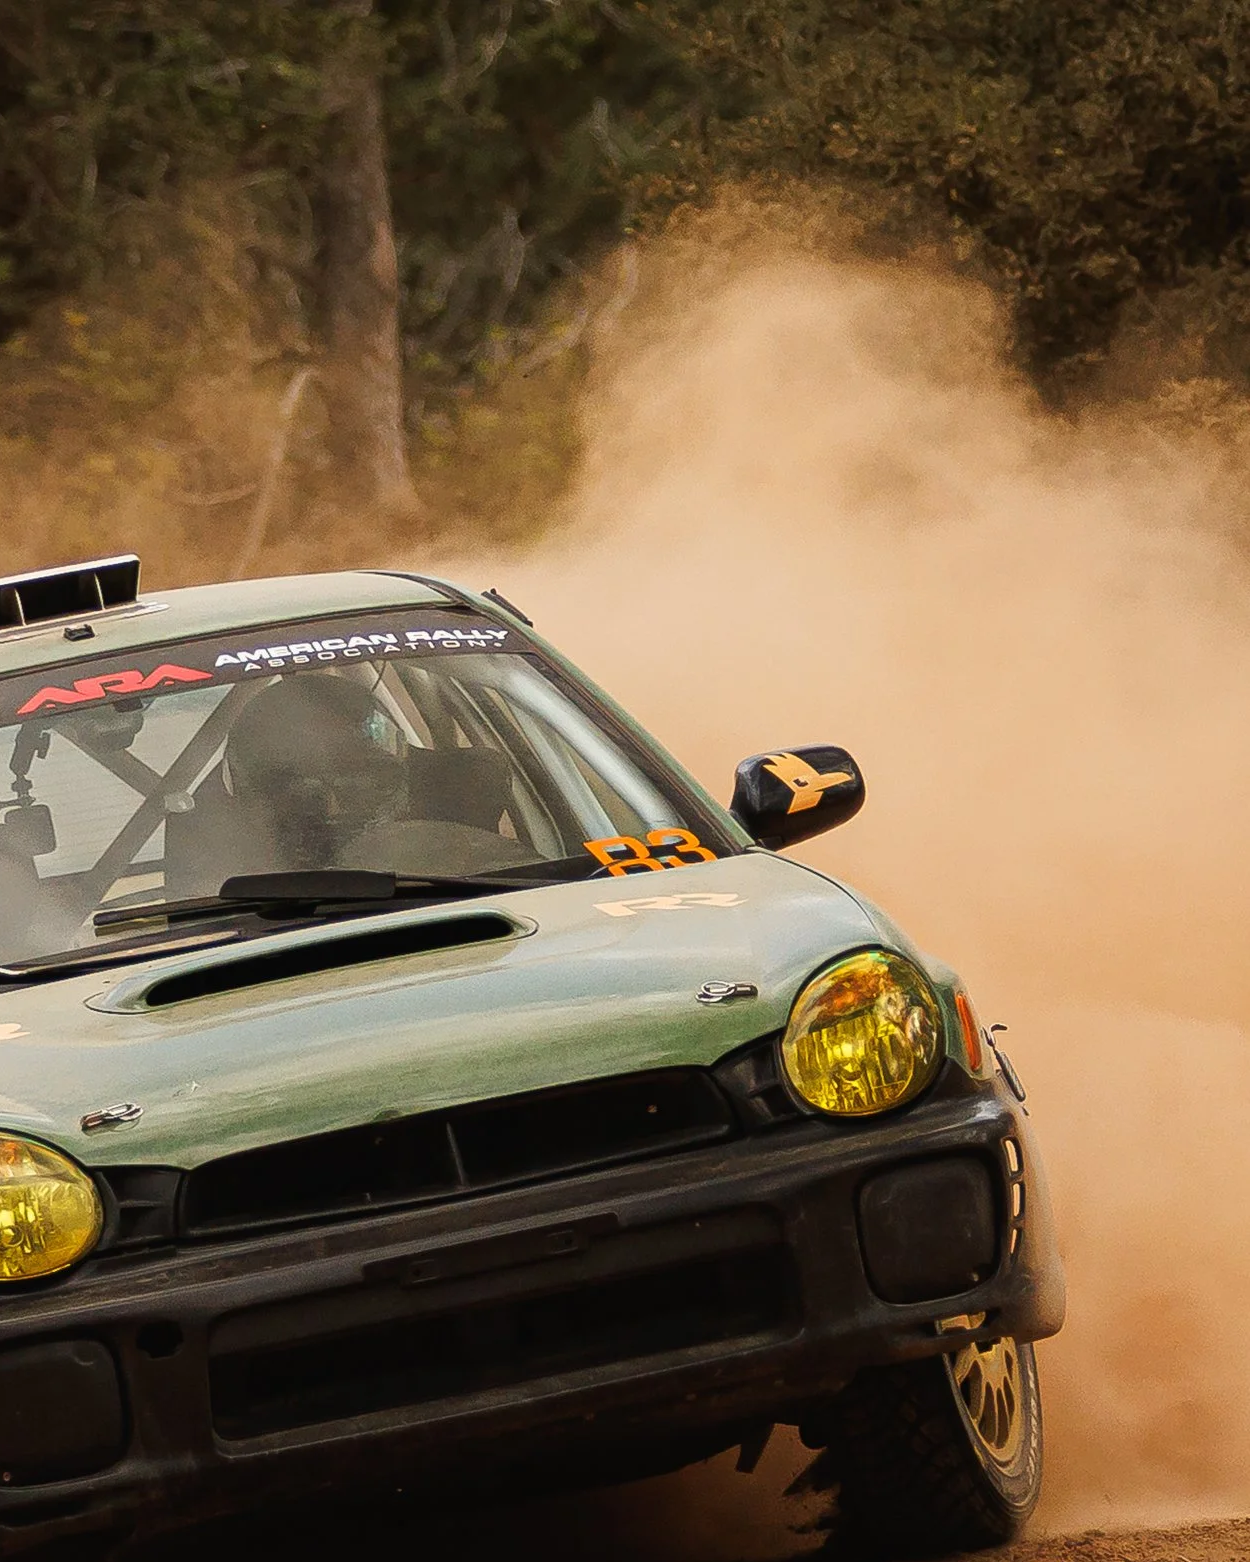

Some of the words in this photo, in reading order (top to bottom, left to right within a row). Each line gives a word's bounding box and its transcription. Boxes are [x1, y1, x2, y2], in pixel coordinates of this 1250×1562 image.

[214, 632, 399, 668] AMERICAN
[404, 628, 509, 642] RALLY
[244, 639, 490, 672] ASSOCIATION
[17, 664, 214, 715] ARA
